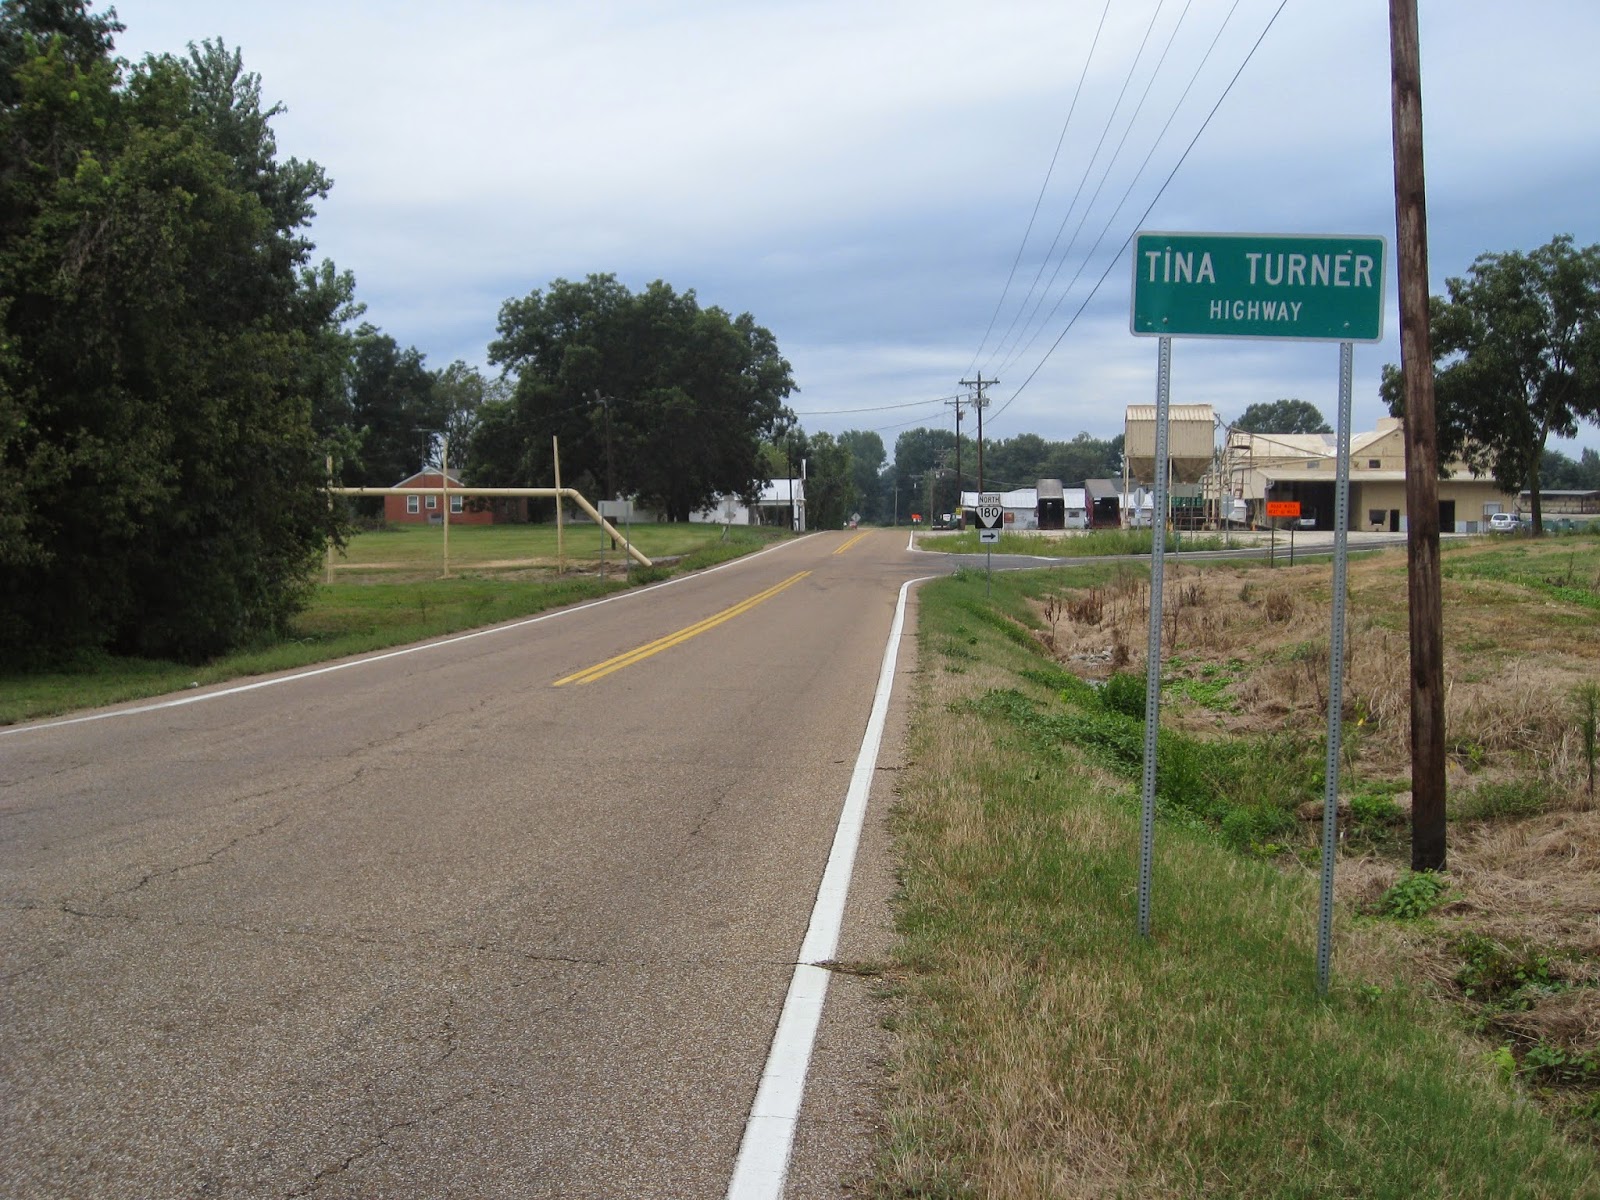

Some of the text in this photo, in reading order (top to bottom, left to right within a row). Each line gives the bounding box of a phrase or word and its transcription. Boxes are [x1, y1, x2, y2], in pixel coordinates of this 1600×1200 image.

[1145, 250, 1374, 287] TINA TURNER
[1209, 300, 1303, 321] HIGHWAY
[980, 507, 999, 518] 180
